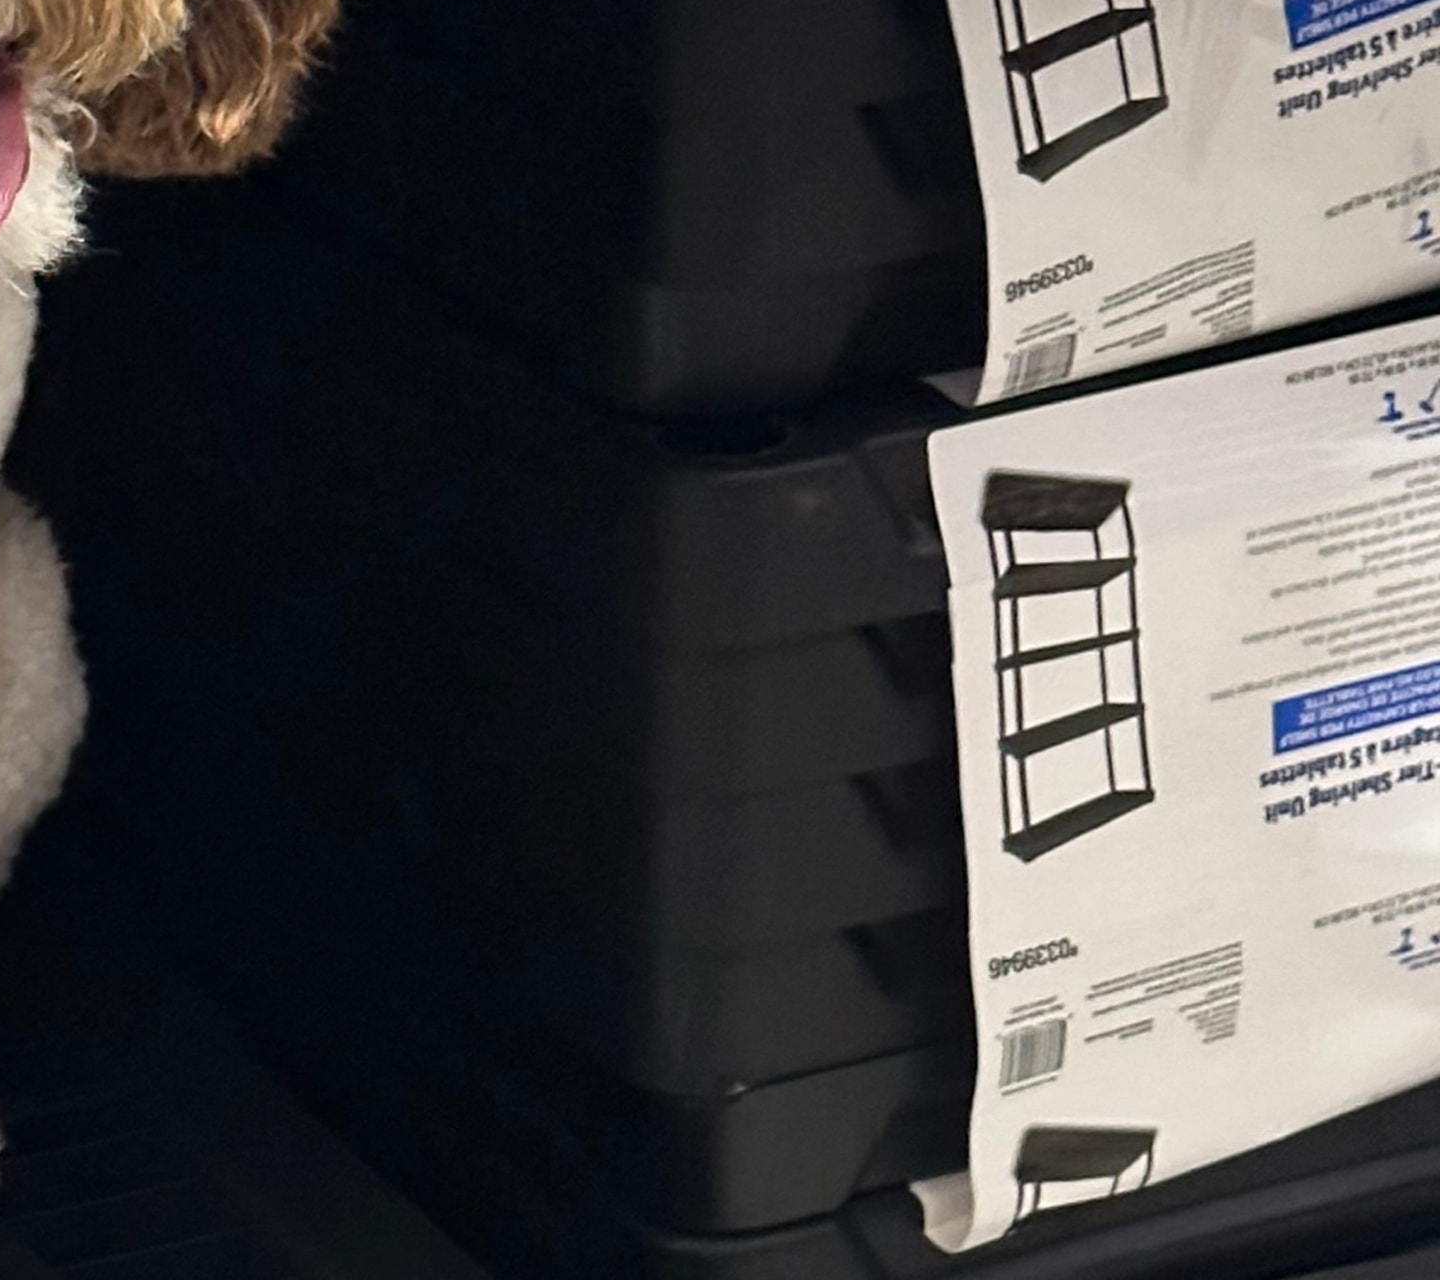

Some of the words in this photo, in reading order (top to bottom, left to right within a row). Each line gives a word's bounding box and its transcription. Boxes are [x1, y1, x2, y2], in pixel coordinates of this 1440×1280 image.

[1273, 40, 1368, 84] tablettes
[1369, 34, 1383, 58] 5
[1326, 57, 1414, 100] Shelving
[1277, 88, 1323, 118] Unit
[1259, 750, 1347, 788] tablettes
[1348, 746, 1362, 769] 5
[1308, 770, 1394, 809] Shelving
[1264, 794, 1306, 824] Unit
